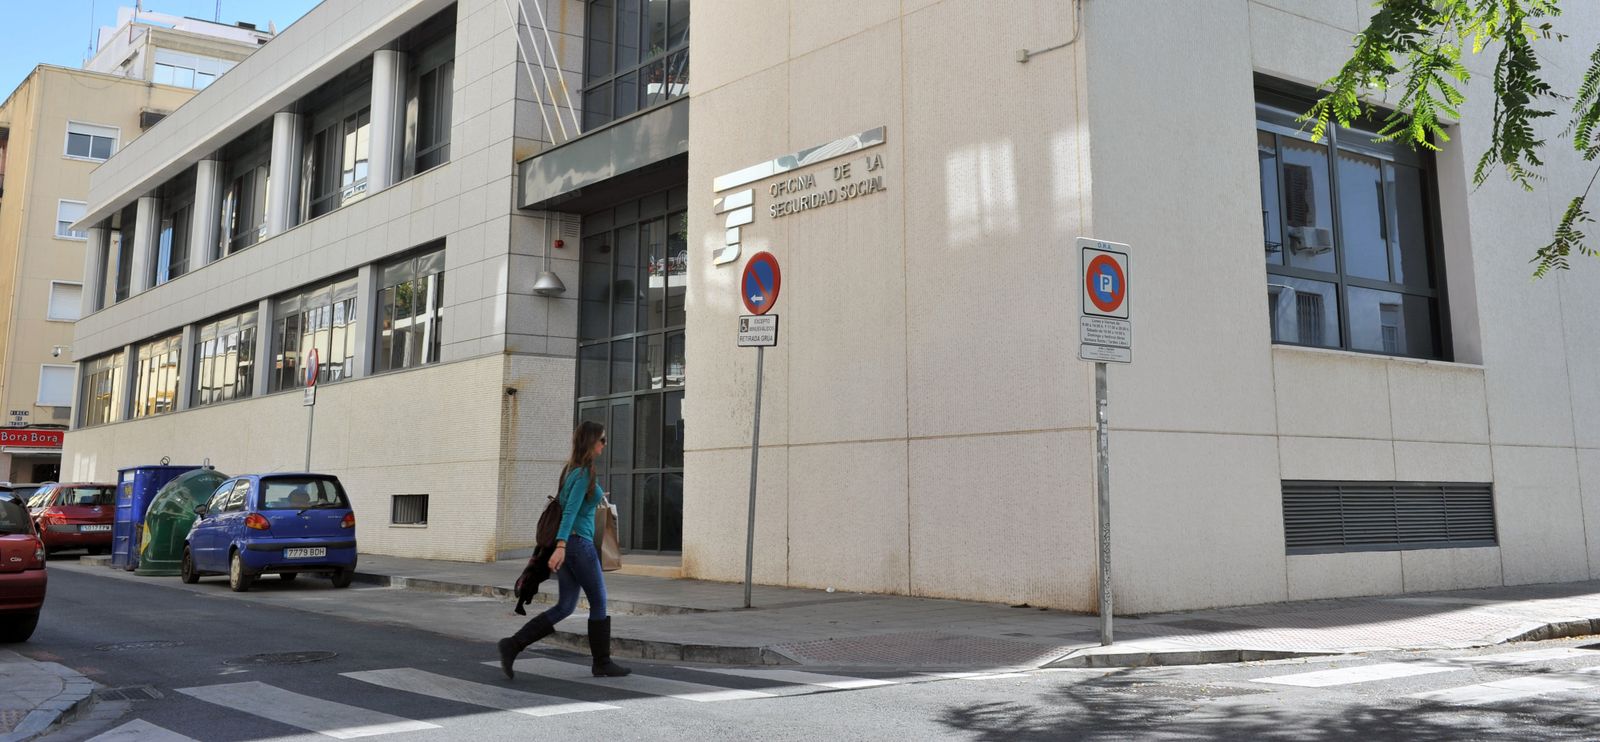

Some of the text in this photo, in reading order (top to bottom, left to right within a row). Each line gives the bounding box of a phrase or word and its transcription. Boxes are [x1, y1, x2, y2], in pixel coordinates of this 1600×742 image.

[769, 154, 884, 198] OFICINA DE LA
[769, 176, 887, 219] SEGURIDAD SOCIAL
[1102, 276, 1110, 290] P
[1, 431, 58, 443] Bora Bora
[288, 549, 308, 557] 7779
